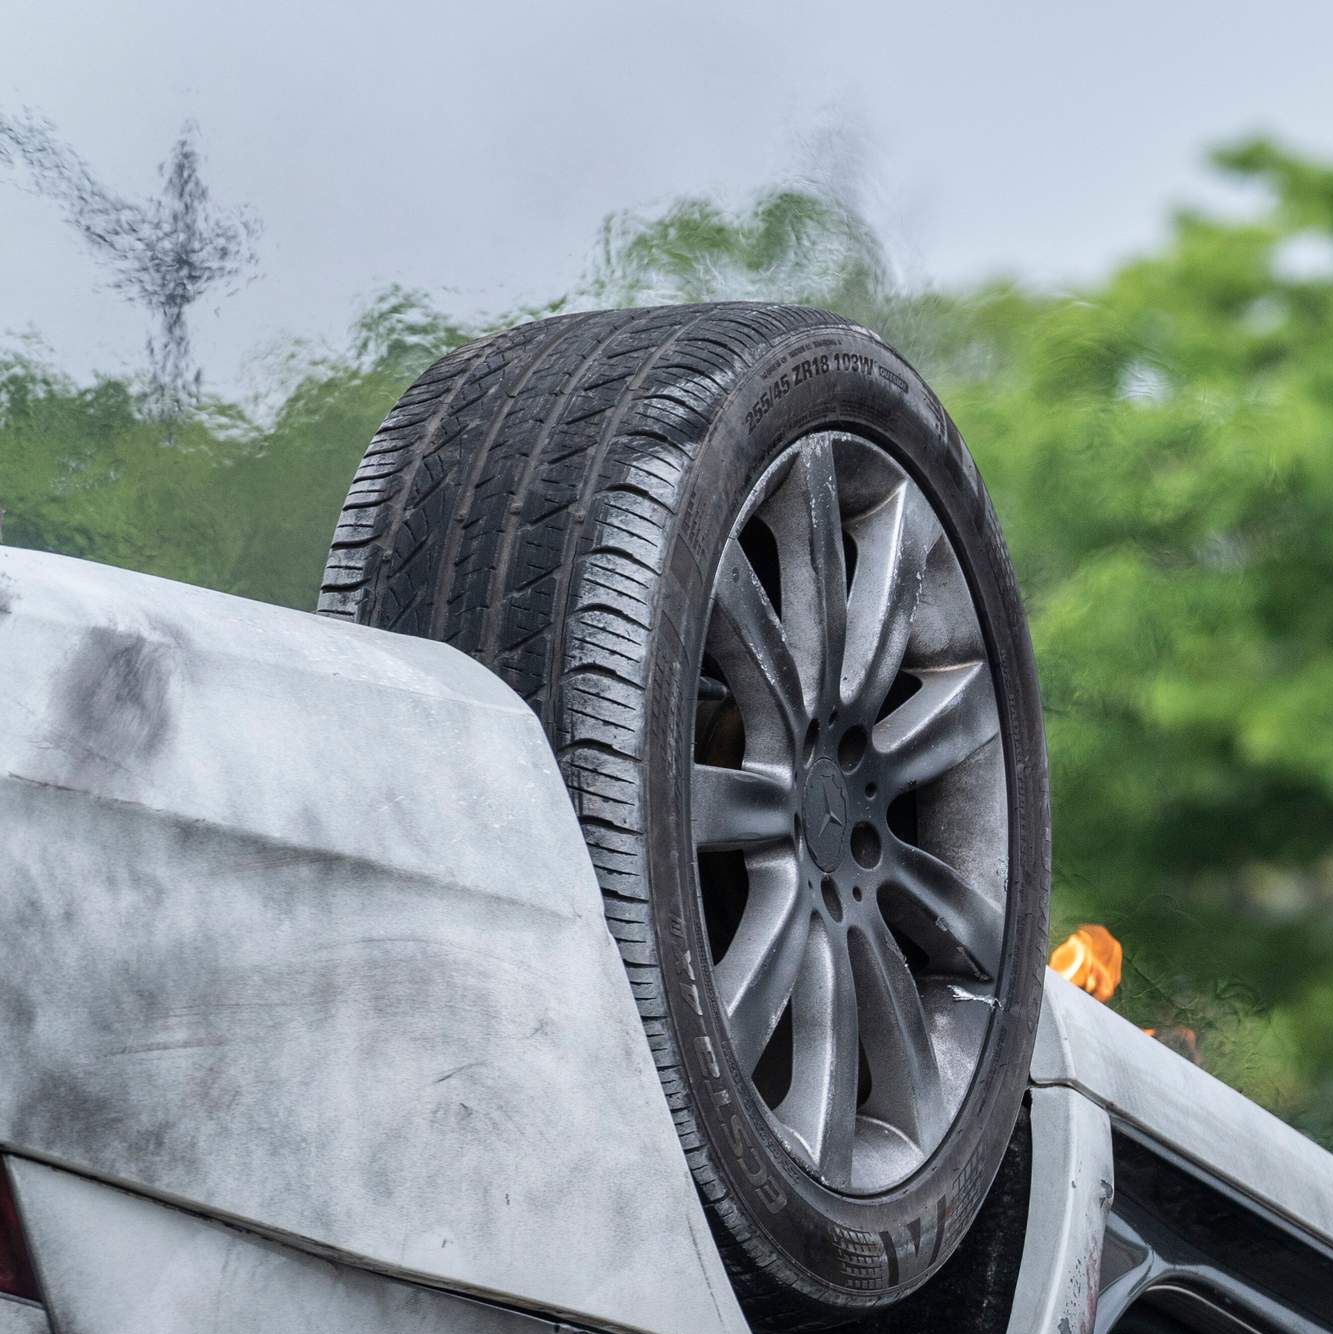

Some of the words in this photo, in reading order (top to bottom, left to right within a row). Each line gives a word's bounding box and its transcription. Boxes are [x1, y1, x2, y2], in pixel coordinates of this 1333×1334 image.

[744, 374, 790, 432] 255/45
[792, 355, 830, 387] ZR18
[834, 353, 874, 376] 103W
